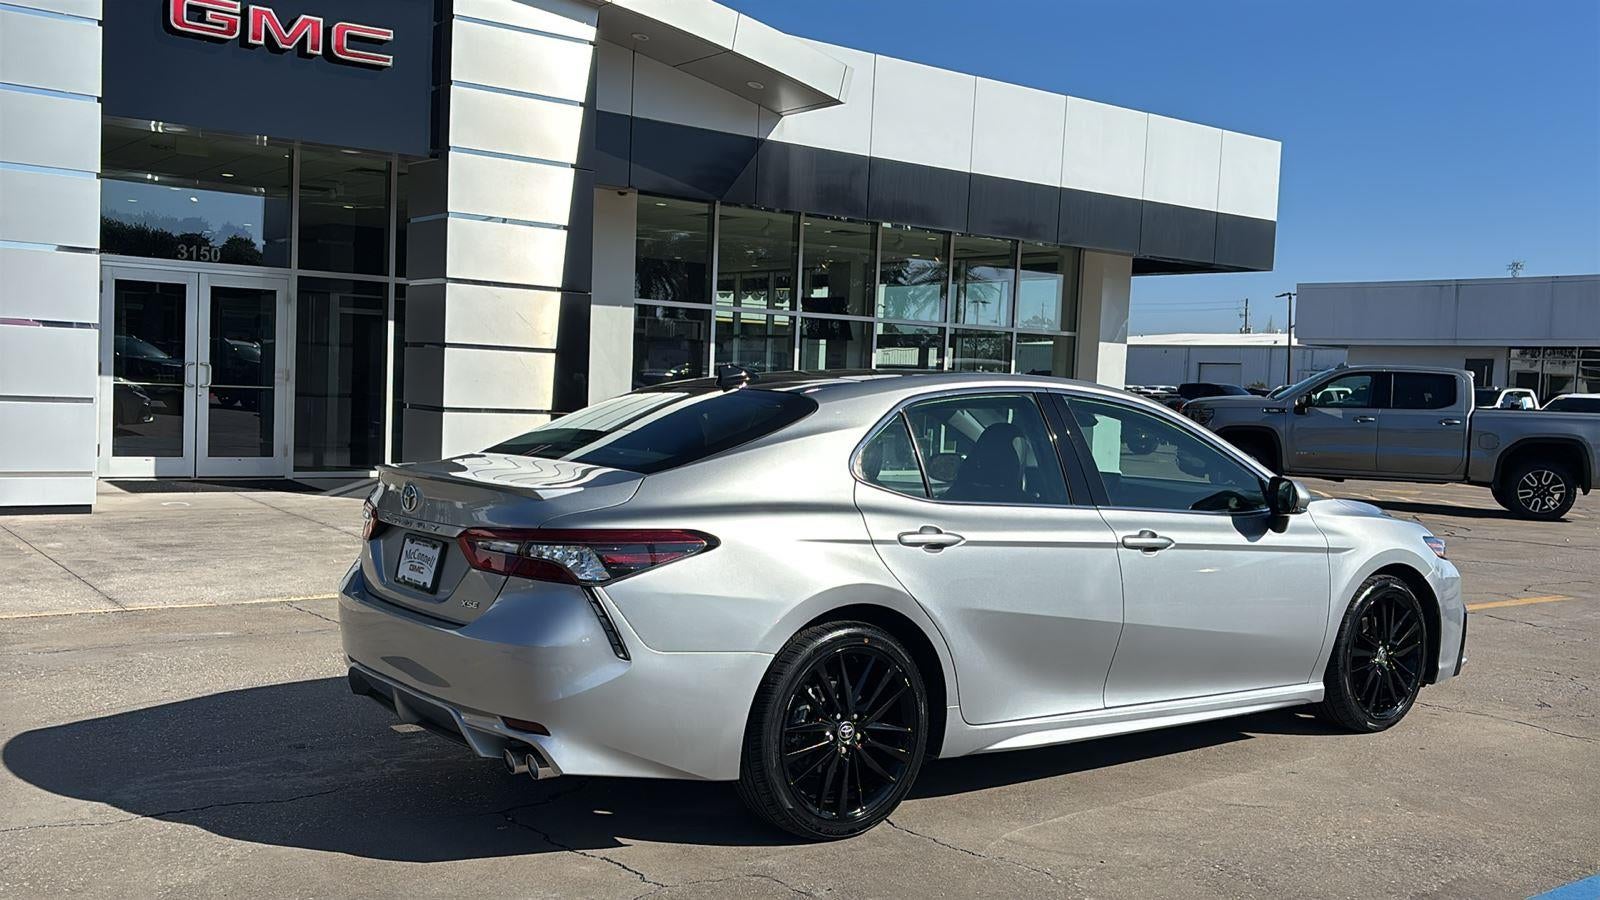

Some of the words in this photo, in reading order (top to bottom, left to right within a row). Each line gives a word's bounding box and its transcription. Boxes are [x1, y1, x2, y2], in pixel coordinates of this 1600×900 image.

[169, 0, 394, 67] GMC
[177, 243, 221, 263] 3150
[408, 564, 425, 575] GMC
[460, 599, 480, 609] XSE
